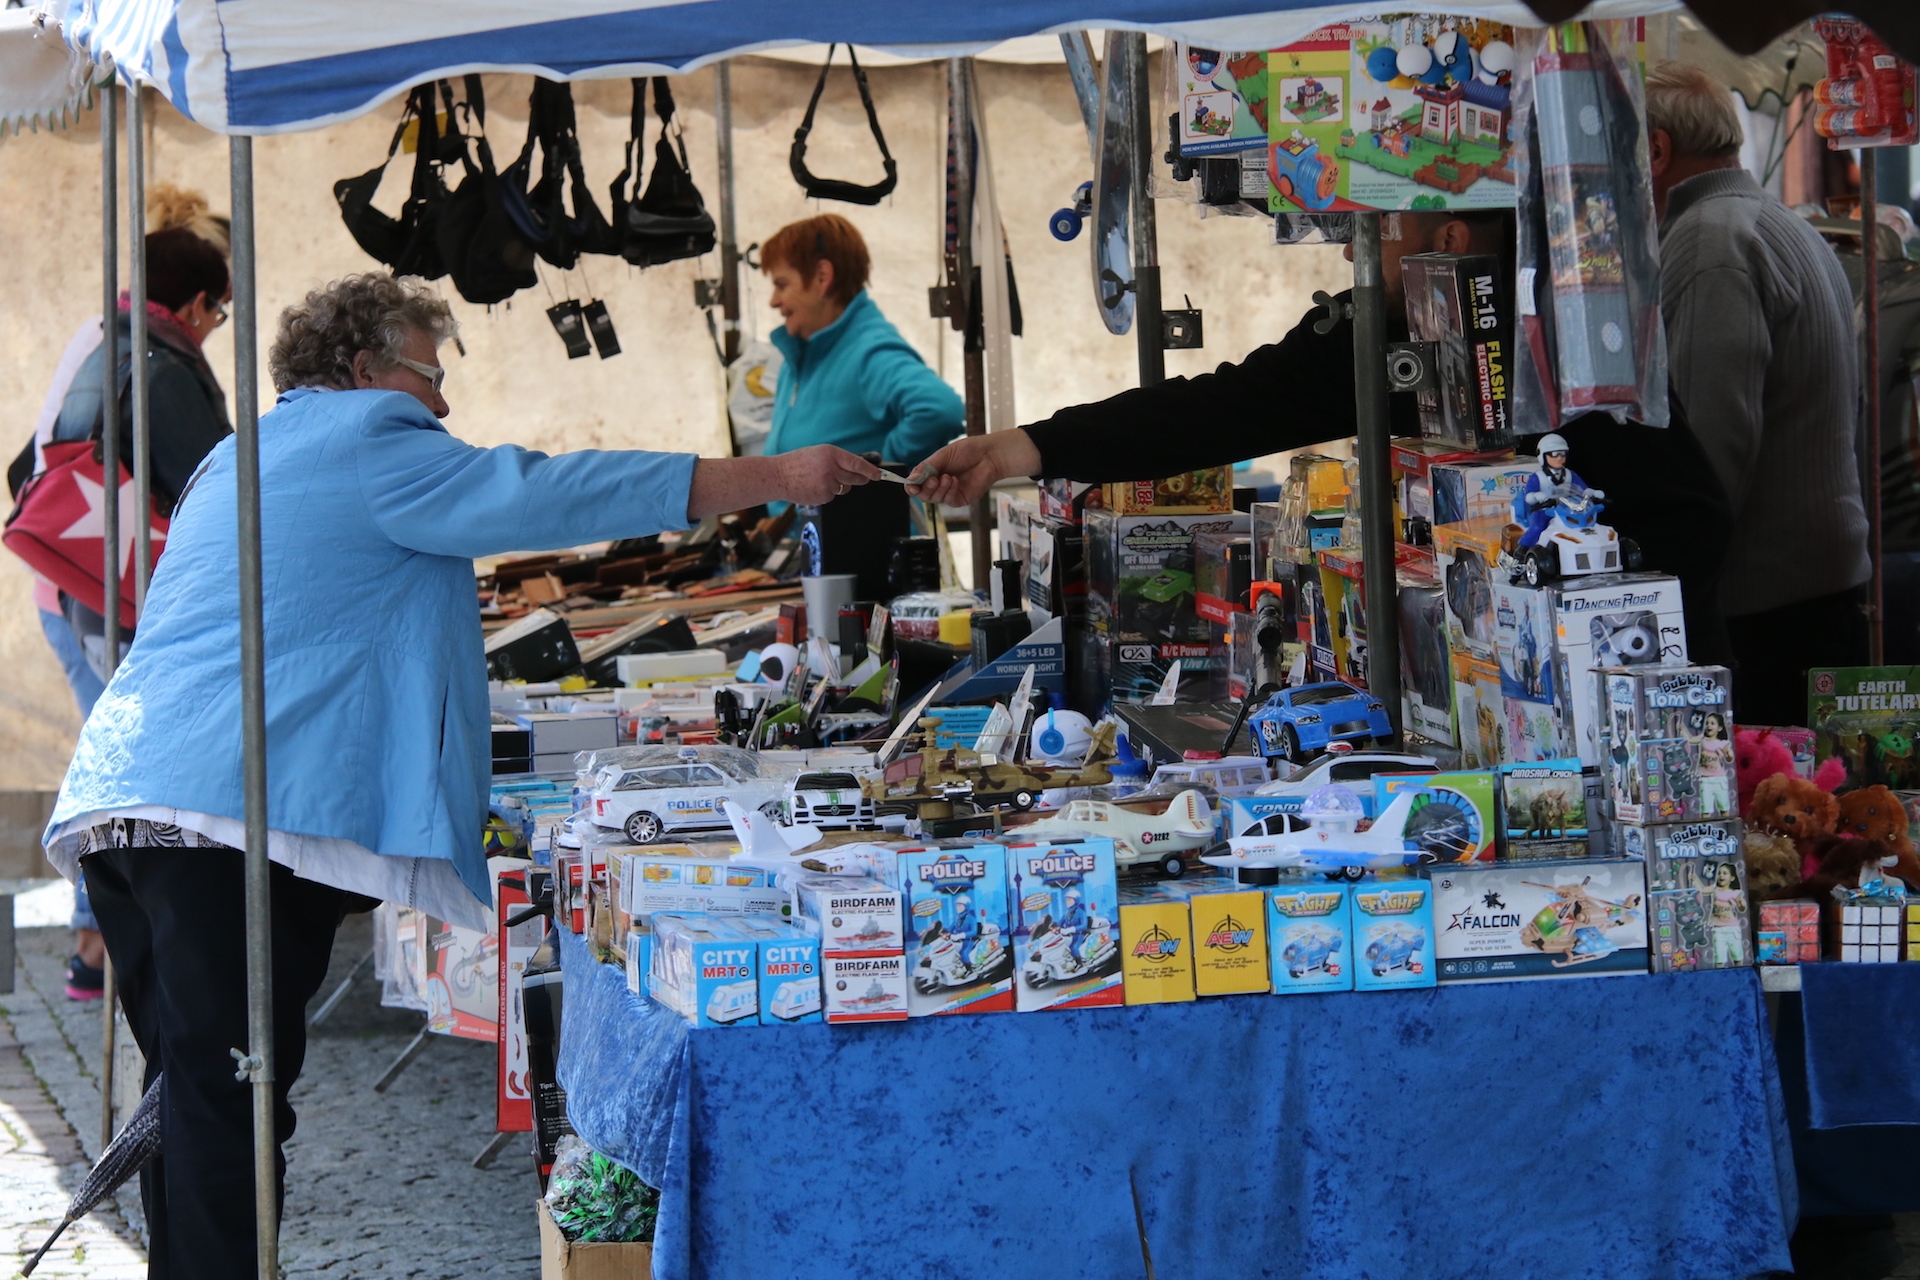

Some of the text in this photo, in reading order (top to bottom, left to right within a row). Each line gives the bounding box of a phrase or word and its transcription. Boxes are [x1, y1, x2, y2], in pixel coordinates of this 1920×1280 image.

[1301, 28, 1366, 42] LOCK TRAIN
[1469, 278, 1477, 308] ASSAULT
[1475, 275, 1506, 401] M-16 FLASH
[1476, 344, 1495, 430] ELECTRIC GUN
[1124, 555, 1160, 565] OFF ROAD
[1573, 591, 1661, 612] DANCING ROBOT
[1016, 647, 1055, 658] 36+5 LED
[1162, 645, 1179, 657] R/C
[1180, 645, 1208, 657] Power
[1858, 680, 1906, 694] EARTH
[1645, 685, 1726, 708] Tom Cat
[1478, 778, 1488, 786] 3+
[1511, 769, 1551, 779] DINOSAUR
[668, 799, 712, 810] POLICE
[1655, 835, 1739, 859] Tom Cat
[919, 861, 985, 881] POLICE
[1029, 855, 1095, 875] POLICE
[831, 897, 896, 909] BIRDFARM
[1284, 895, 1336, 912] FLIGHT
[1367, 893, 1419, 911] FLIGHT
[1463, 914, 1521, 930] FALCON
[1204, 929, 1255, 947] AEW
[765, 946, 814, 963] CITY
[1131, 937, 1182, 957] AEW
[702, 949, 749, 966] CITY
[702, 963, 739, 978] MRT
[766, 961, 801, 975] MRT
[835, 960, 899, 972] BIRDFARM
[539, 1082, 555, 1090] Tips:
